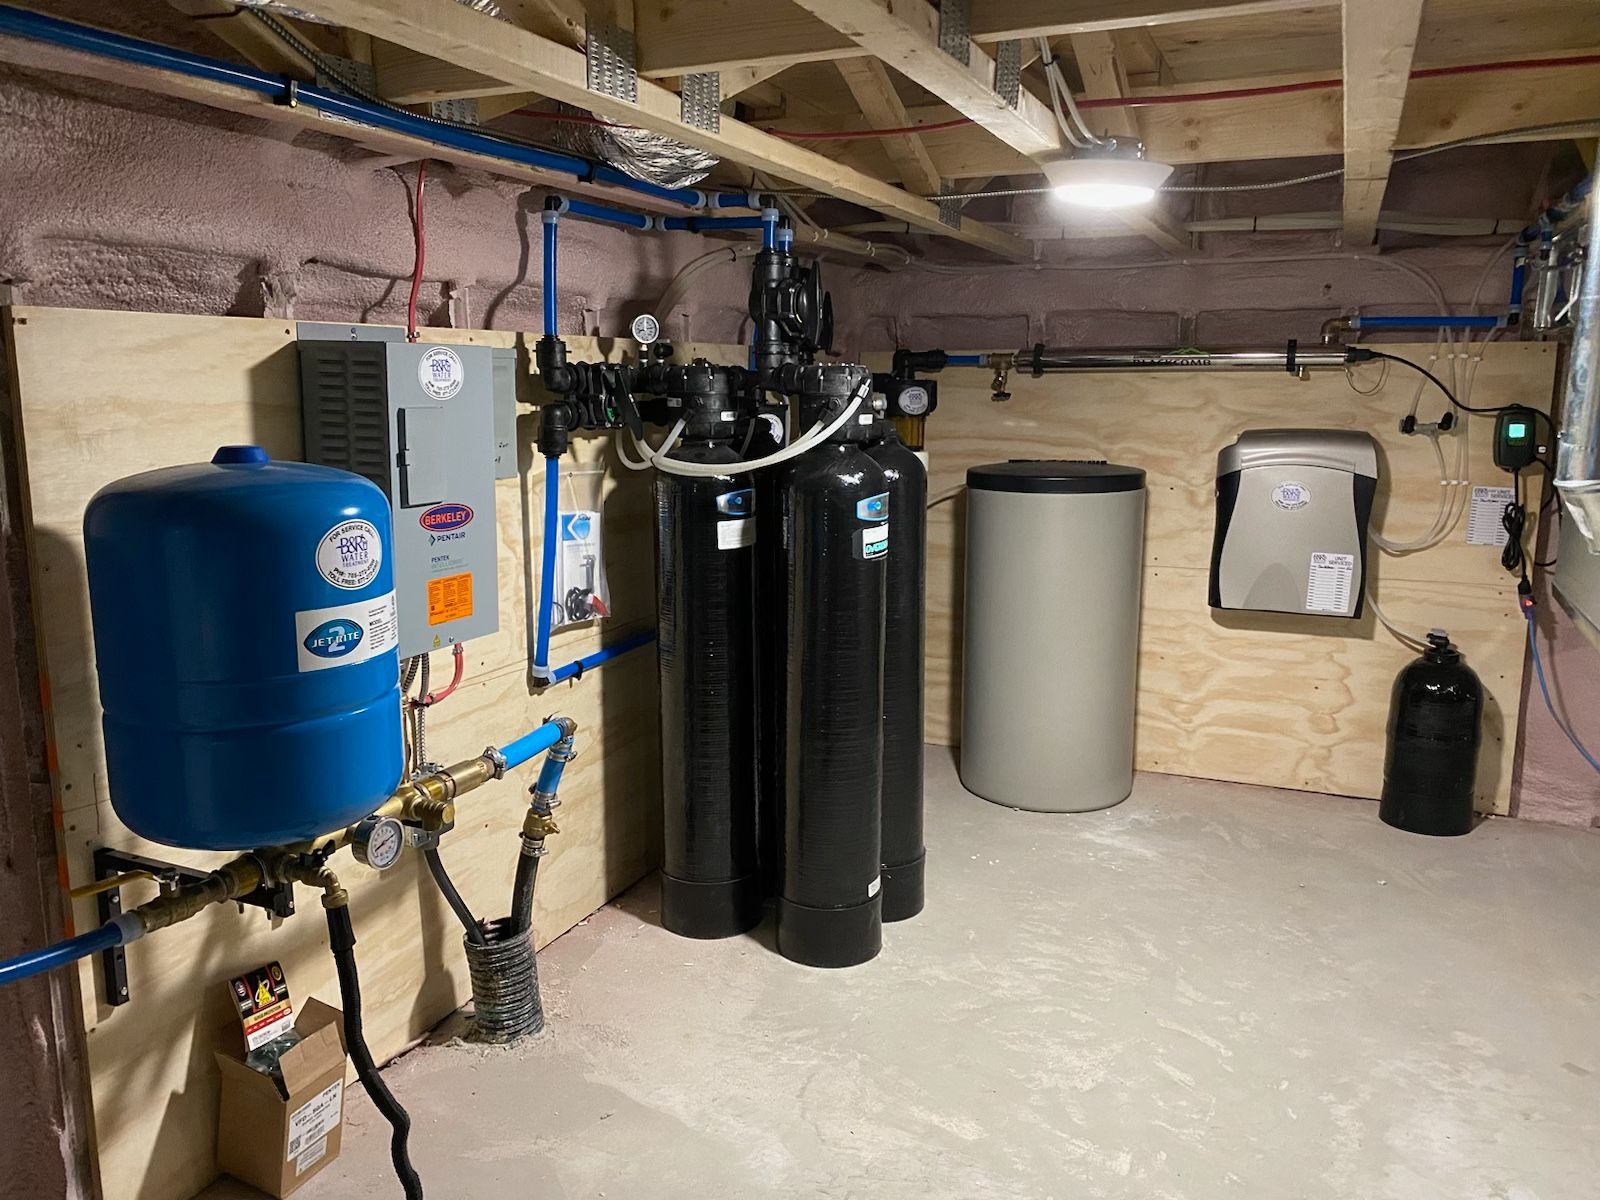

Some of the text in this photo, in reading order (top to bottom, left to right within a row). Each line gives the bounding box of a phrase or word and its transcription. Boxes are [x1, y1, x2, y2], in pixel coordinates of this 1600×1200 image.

[1134, 359, 1212, 367] BLACKCOMB
[424, 510, 467, 526] BERKELEY
[328, 530, 341, 543] FOR
[341, 524, 364, 534] SERVICE
[436, 532, 466, 543] PENTAIR
[341, 550, 369, 563] WATER
[431, 554, 450, 563] PENTEK
[327, 570, 340, 584] TOLL
[312, 631, 360, 648] JET RITE
